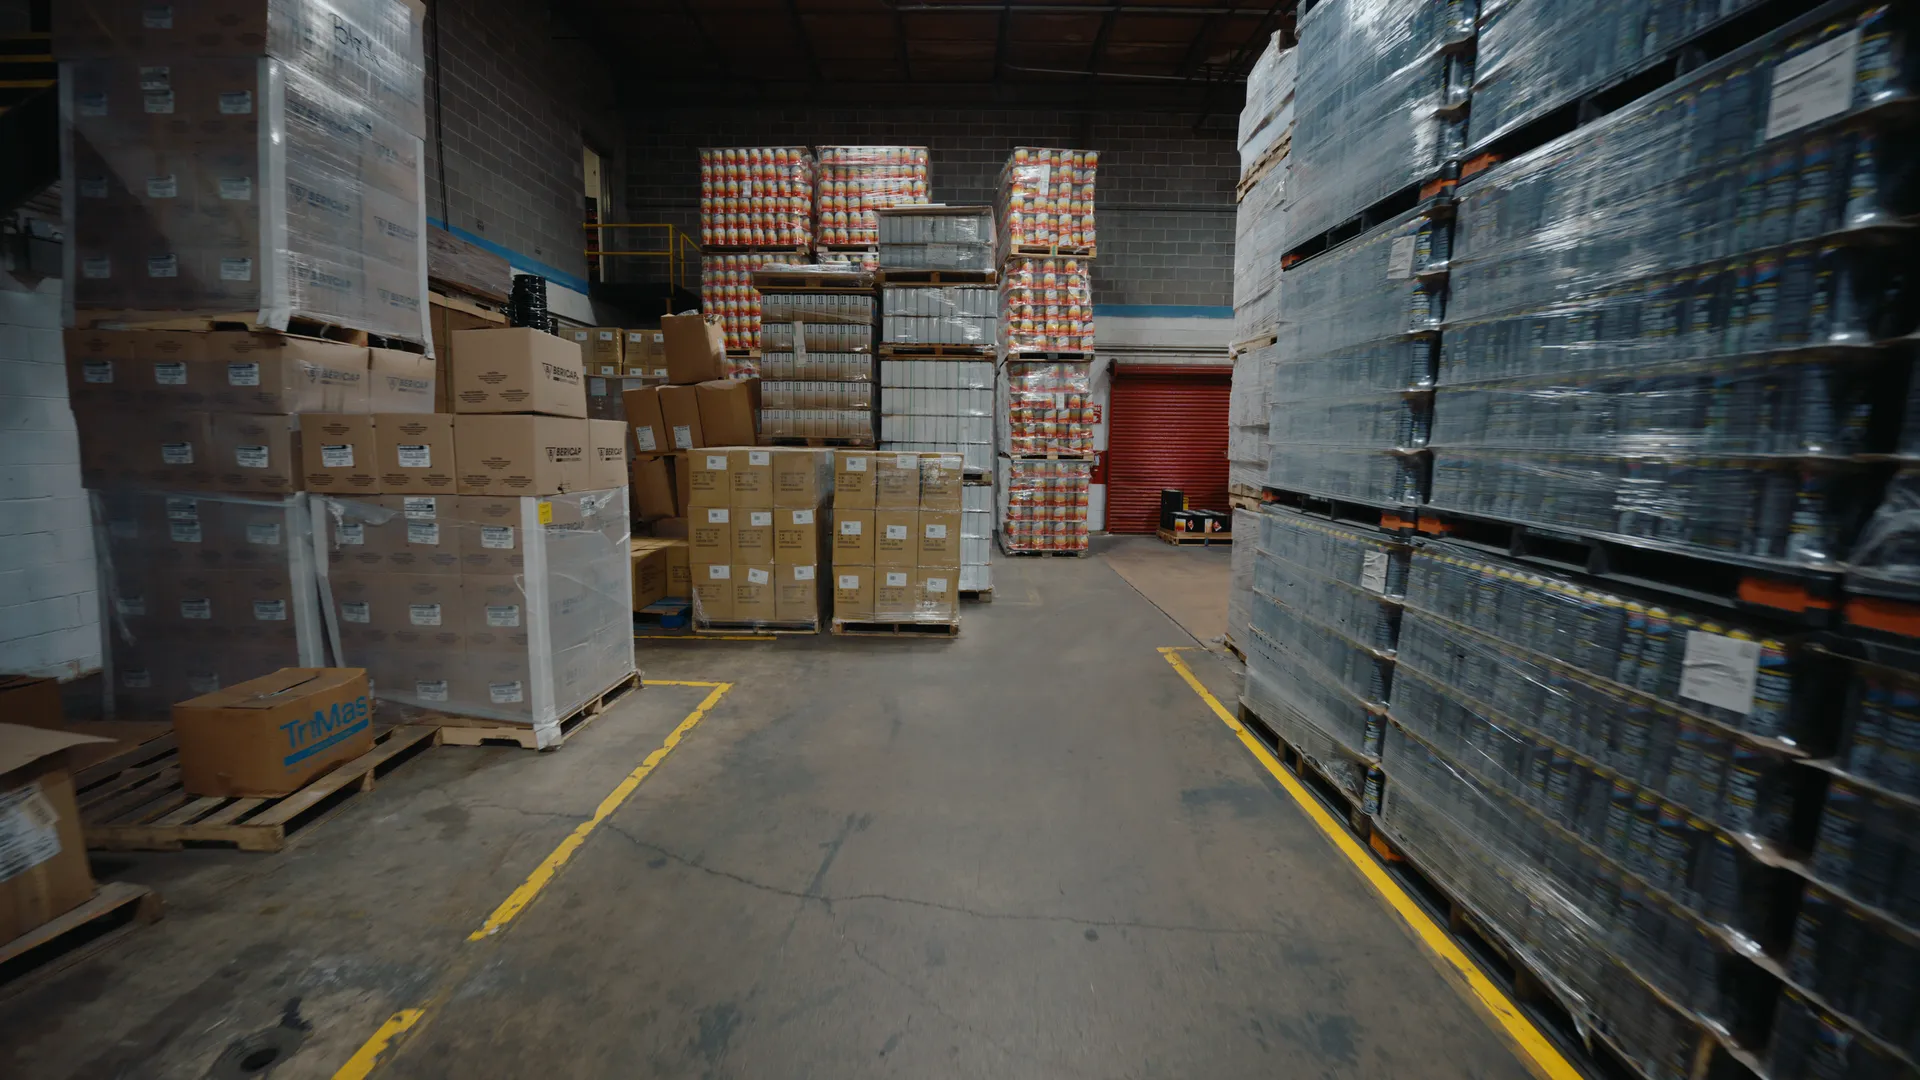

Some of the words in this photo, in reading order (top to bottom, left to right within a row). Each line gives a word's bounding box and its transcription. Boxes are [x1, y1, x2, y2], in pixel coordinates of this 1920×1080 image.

[322, 369, 360, 381] BERICAP
[552, 366, 577, 379] BERICAP
[398, 380, 428, 389] BERICAP
[556, 447, 582, 456] BERICAP
[605, 447, 622, 456] BERICAP
[279, 695, 368, 749] TriMas
